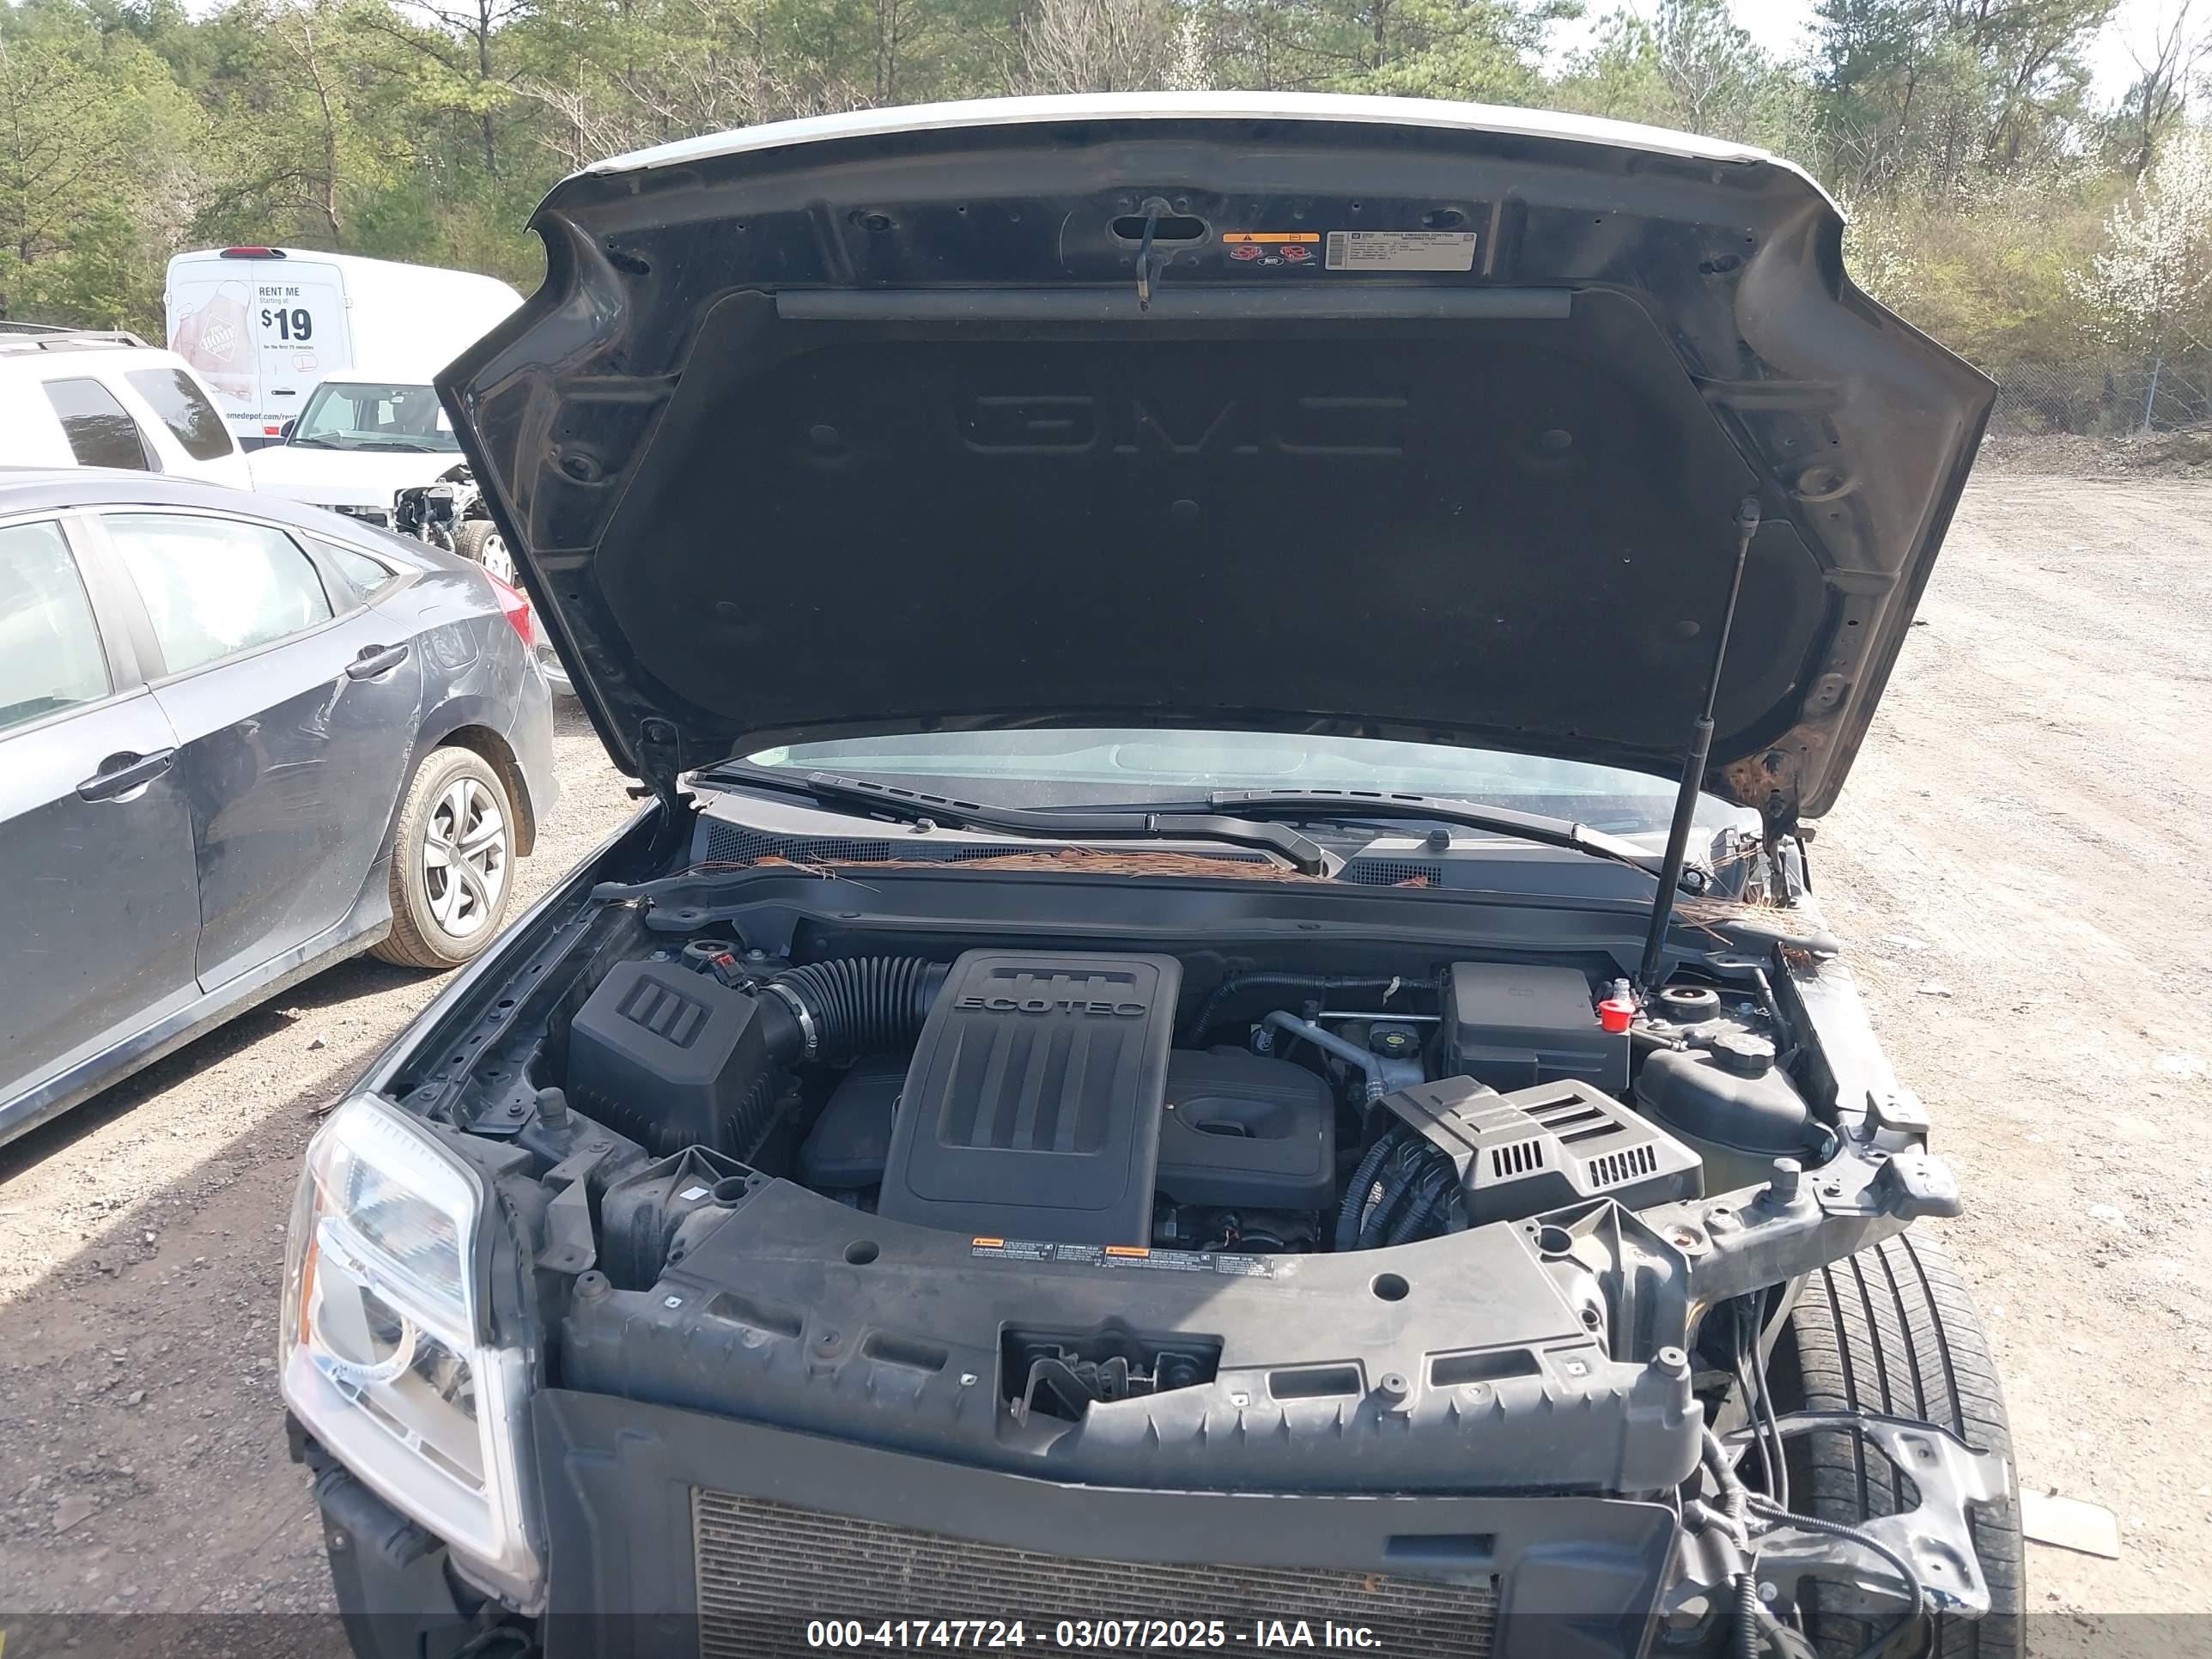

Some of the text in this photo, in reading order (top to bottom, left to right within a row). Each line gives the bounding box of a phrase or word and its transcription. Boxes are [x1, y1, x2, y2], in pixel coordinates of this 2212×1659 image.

[259, 286, 300, 296] RENT ME
[261, 307, 313, 341] $19
[953, 395, 1408, 455] GMC
[954, 995, 1147, 1018] ECOTEC
